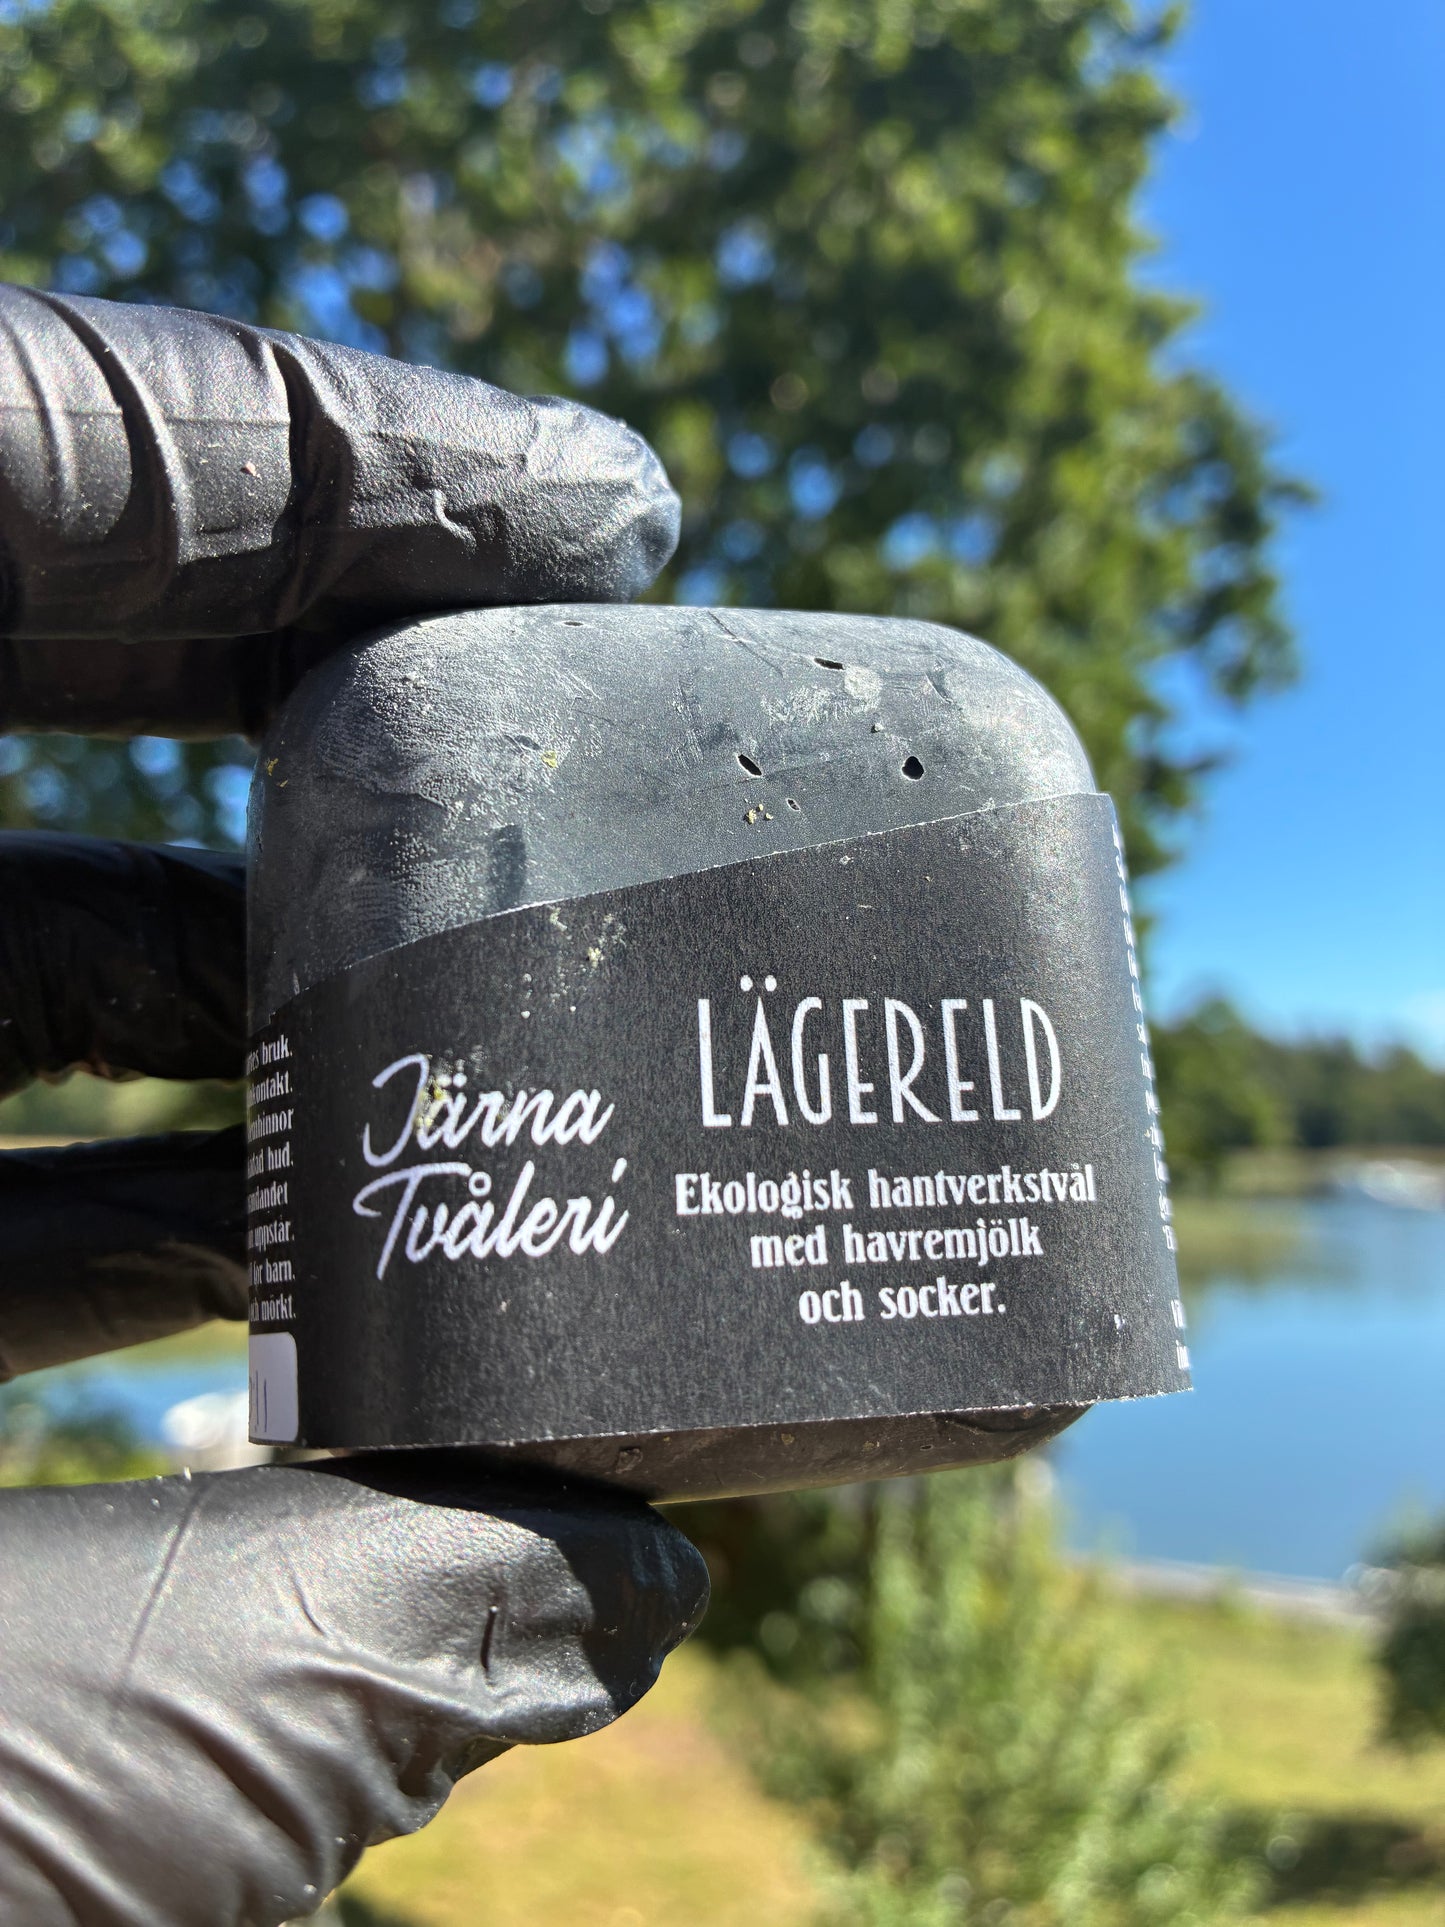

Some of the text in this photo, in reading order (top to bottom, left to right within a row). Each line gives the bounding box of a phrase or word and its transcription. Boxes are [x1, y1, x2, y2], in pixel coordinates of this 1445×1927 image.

[262, 1034, 293, 1066] bruk.
[698, 974, 1061, 1128] LÄGERELD
[363, 1052, 615, 1168] Järna
[267, 1141, 293, 1171] hud.
[675, 1169, 853, 1220] Ekologisk
[868, 1162, 1097, 1209] hantverkstvål
[353, 1157, 629, 1281] Tvåleri
[750, 1217, 1045, 1268] med havremjölk
[265, 1258, 295, 1283] barn.
[261, 1293, 296, 1320] mörkt.
[799, 1276, 1006, 1324] och socker.
